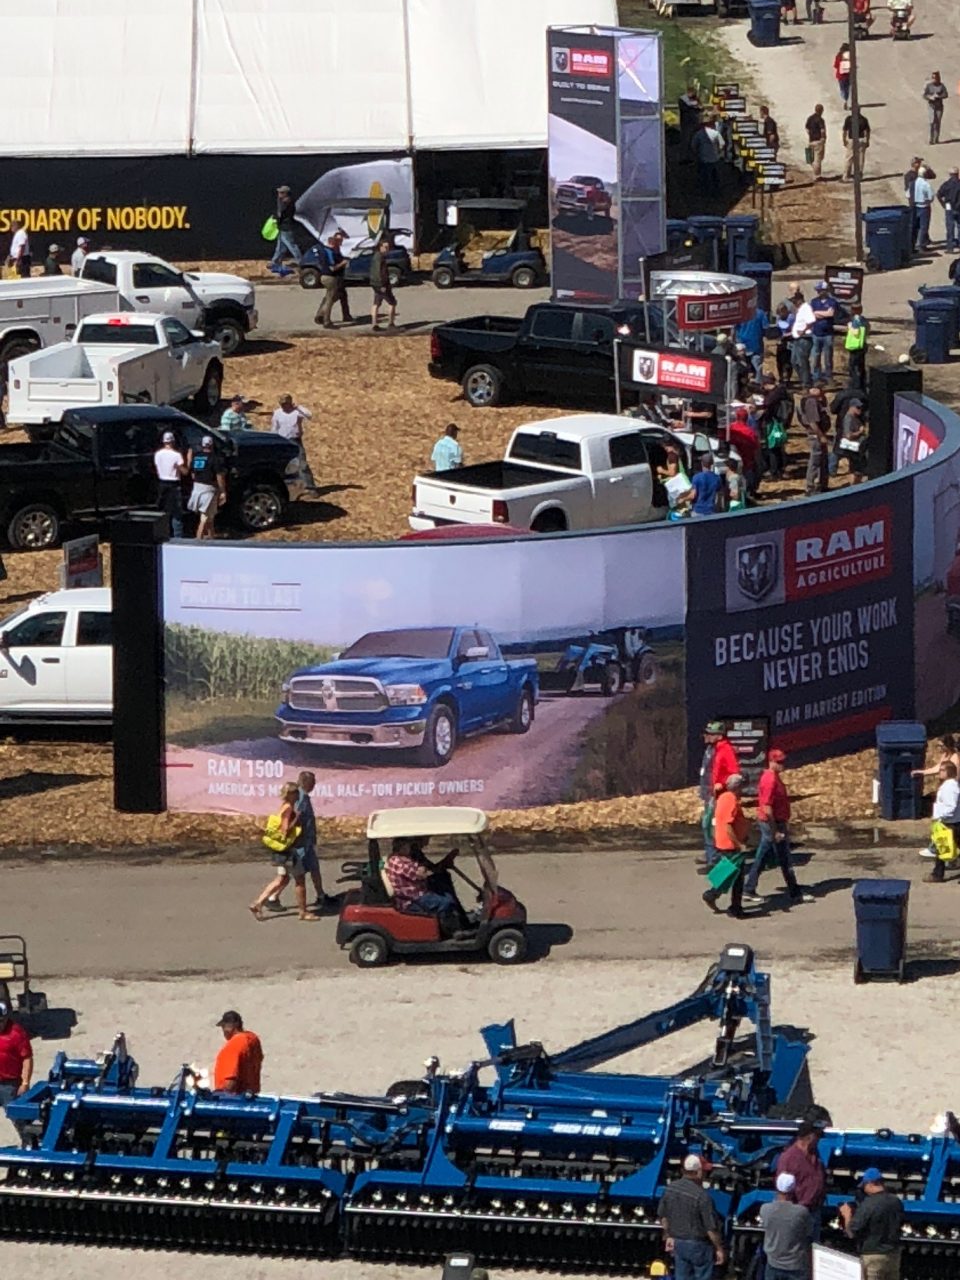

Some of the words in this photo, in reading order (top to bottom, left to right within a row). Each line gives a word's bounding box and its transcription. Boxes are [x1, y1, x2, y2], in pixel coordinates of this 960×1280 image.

[572, 53, 608, 65] RAM
[77, 208, 101, 231] OF
[106, 206, 191, 230] NOBODY.
[708, 300, 740, 312] RAM
[661, 360, 707, 378] RAM
[795, 520, 885, 563] RAM
[796, 555, 886, 589] AGRICULTURE
[715, 622, 804, 666] BECAUSE
[810, 611, 853, 647] YOUR
[857, 597, 897, 635] WORK
[763, 652, 823, 691] NEVER
[828, 640, 869, 675] ENDS
[775, 706, 800, 726] RAM
[804, 693, 848, 719] HARVEST
[851, 684, 887, 707] EDITION
[207, 759, 241, 777] RAM
[248, 759, 284, 778] 1500
[208, 782, 265, 797] AMERICA'S
[337, 781, 393, 798] HALF-TON
[395, 780, 435, 796] PICKUP
[438, 778, 485, 795] OWNERS
